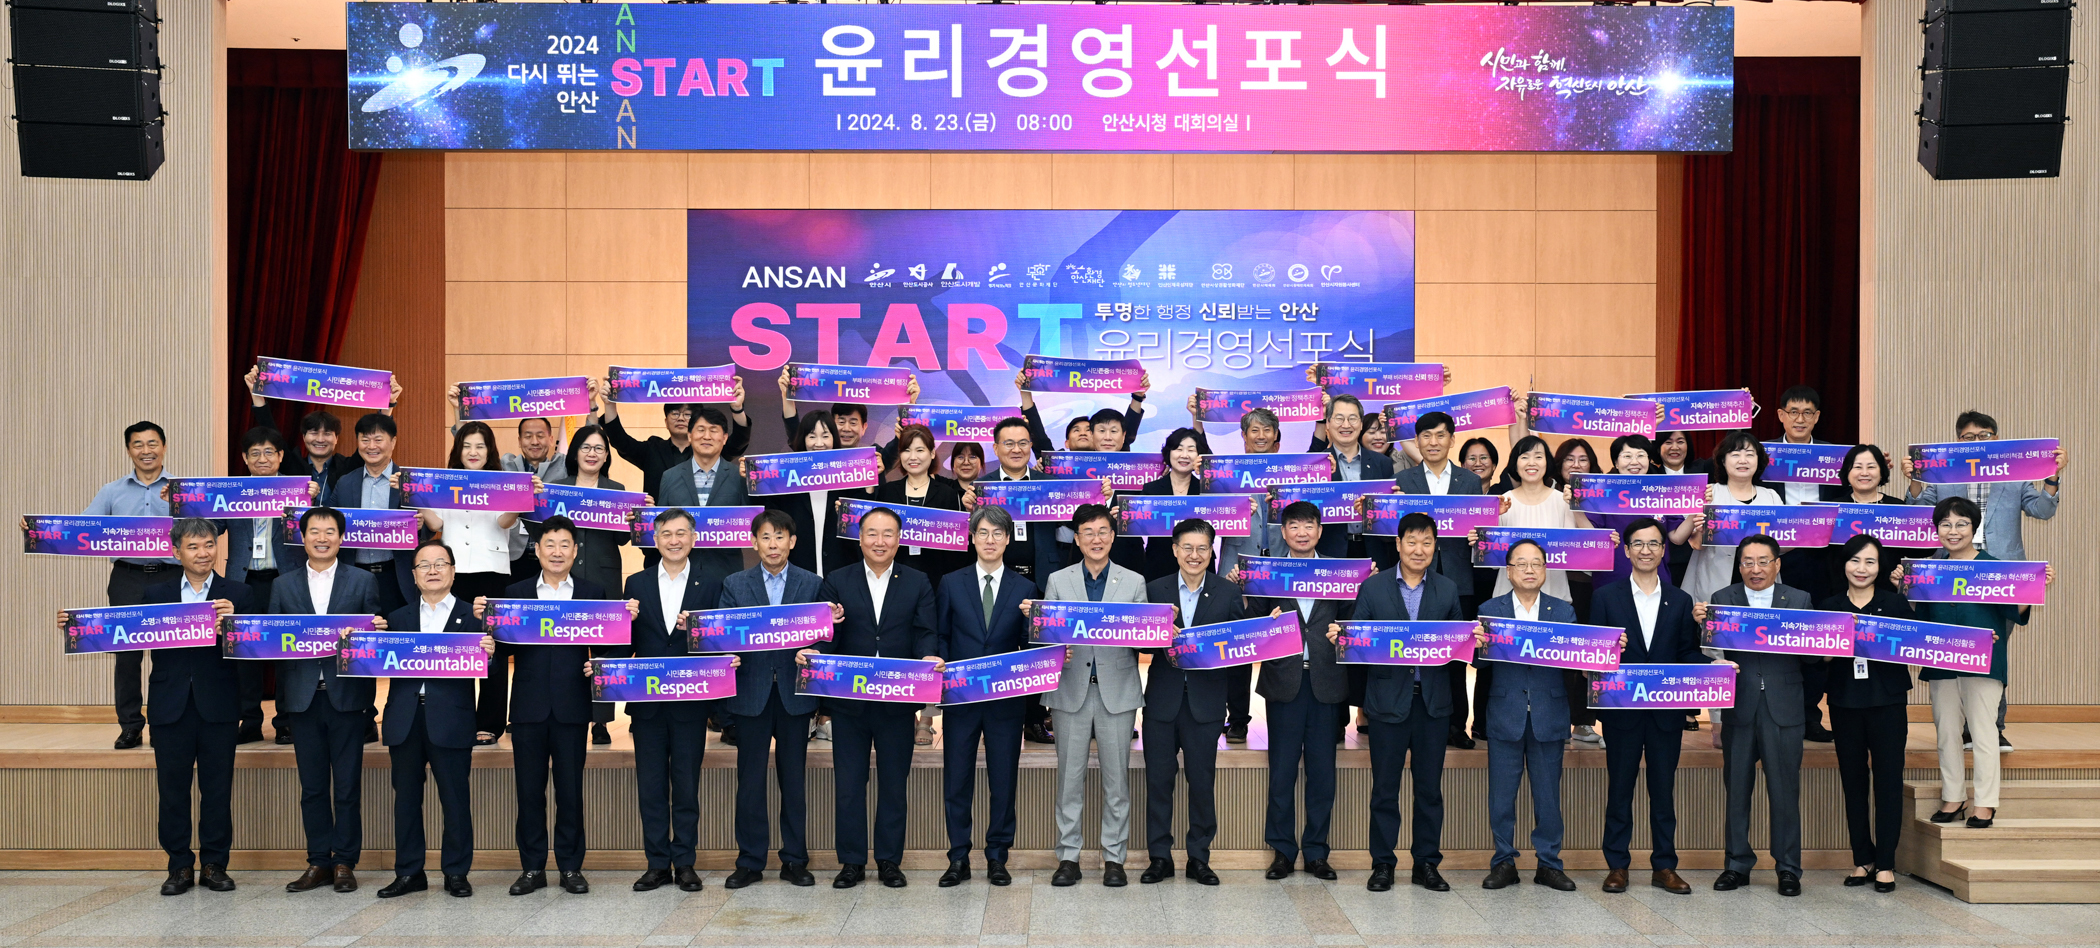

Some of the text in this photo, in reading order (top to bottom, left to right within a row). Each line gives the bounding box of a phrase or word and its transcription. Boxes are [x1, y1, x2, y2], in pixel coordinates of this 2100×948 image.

[547, 35, 599, 55] 2024
[815, 23, 1387, 99] 윤리경영선포식
[1480, 47, 1530, 78] 시민과
[507, 63, 599, 86] 다시 뛰는
[610, 58, 784, 96] START
[1495, 77, 1543, 101] 자유로운
[1607, 76, 1651, 95] 안산
[557, 90, 599, 114] 안산
[848, 112, 1238, 133] 2024. 8. 23.(금) 08:00 안산시청 대회의실
[742, 266, 846, 288] ANSAN
[1094, 303, 1319, 321] 투명한 행정 신뢰받는 안산
[723, 302, 1083, 371] START
[1094, 329, 1373, 369] 윤리경영선포식
[259, 372, 298, 383] START
[791, 377, 826, 387] START
[1025, 369, 1060, 378] START
[1069, 371, 1123, 391] Respect
[1320, 376, 1355, 385] START
[306, 379, 365, 402] Respect
[611, 379, 647, 388] START
[647, 380, 732, 398] Accountable
[834, 381, 870, 399] Trust
[1364, 378, 1401, 395] Trust
[462, 395, 498, 405] START
[509, 395, 565, 414] Respect
[1530, 407, 1565, 418] START
[1670, 407, 1749, 425] Sustainable
[946, 420, 994, 439] Respec
[1572, 411, 1652, 434] Sustainable
[1914, 458, 1953, 468] START
[1965, 458, 2009, 477] Trust
[749, 468, 786, 479] START
[786, 467, 875, 487] Accountable
[402, 482, 440, 493] START
[450, 487, 489, 505] Trust
[1573, 488, 1612, 498] START
[173, 493, 213, 502] START
[1618, 490, 1704, 509] Sustainable
[553, 501, 628, 524] Accountab
[1468, 507, 1481, 515] 신뢰
[1482, 507, 1494, 515] 행정
[1437, 517, 1453, 531] ust
[1707, 519, 1746, 529] START
[1756, 522, 1796, 541] Trust
[29, 530, 70, 540] START
[77, 533, 169, 552] Sustainable
[342, 529, 414, 543] ustainable
[1546, 550, 1567, 564] ust
[1239, 570, 1277, 580] START
[1281, 572, 1360, 594] Transparen
[1903, 574, 1942, 584] START
[1952, 577, 2015, 598] Respect
[69, 624, 112, 636] START
[486, 616, 529, 626] START
[540, 618, 604, 639] Respect
[1033, 617, 1074, 627] START
[1073, 620, 1169, 641] Accountable
[1706, 622, 1748, 633] START
[113, 624, 214, 644] Accountable
[226, 631, 269, 641] START
[691, 625, 732, 637] START
[735, 625, 830, 648] Transparent
[1483, 632, 1521, 645] START
[1754, 625, 1850, 651] Sustainable
[281, 632, 337, 653] Respec
[1214, 640, 1257, 661] Trust
[1339, 636, 1379, 646] START
[1390, 639, 1451, 659] Respect
[341, 649, 384, 659] START
[383, 650, 483, 671] Accountable
[1520, 638, 1616, 665] Accountable
[1887, 636, 1988, 667] Transparent
[594, 675, 635, 684] START
[801, 669, 843, 681] START
[979, 671, 1061, 694] Transparen
[646, 675, 709, 697] Respect
[853, 675, 915, 697] Respect
[1592, 681, 1633, 691] START
[1632, 682, 1731, 702] Accountable
